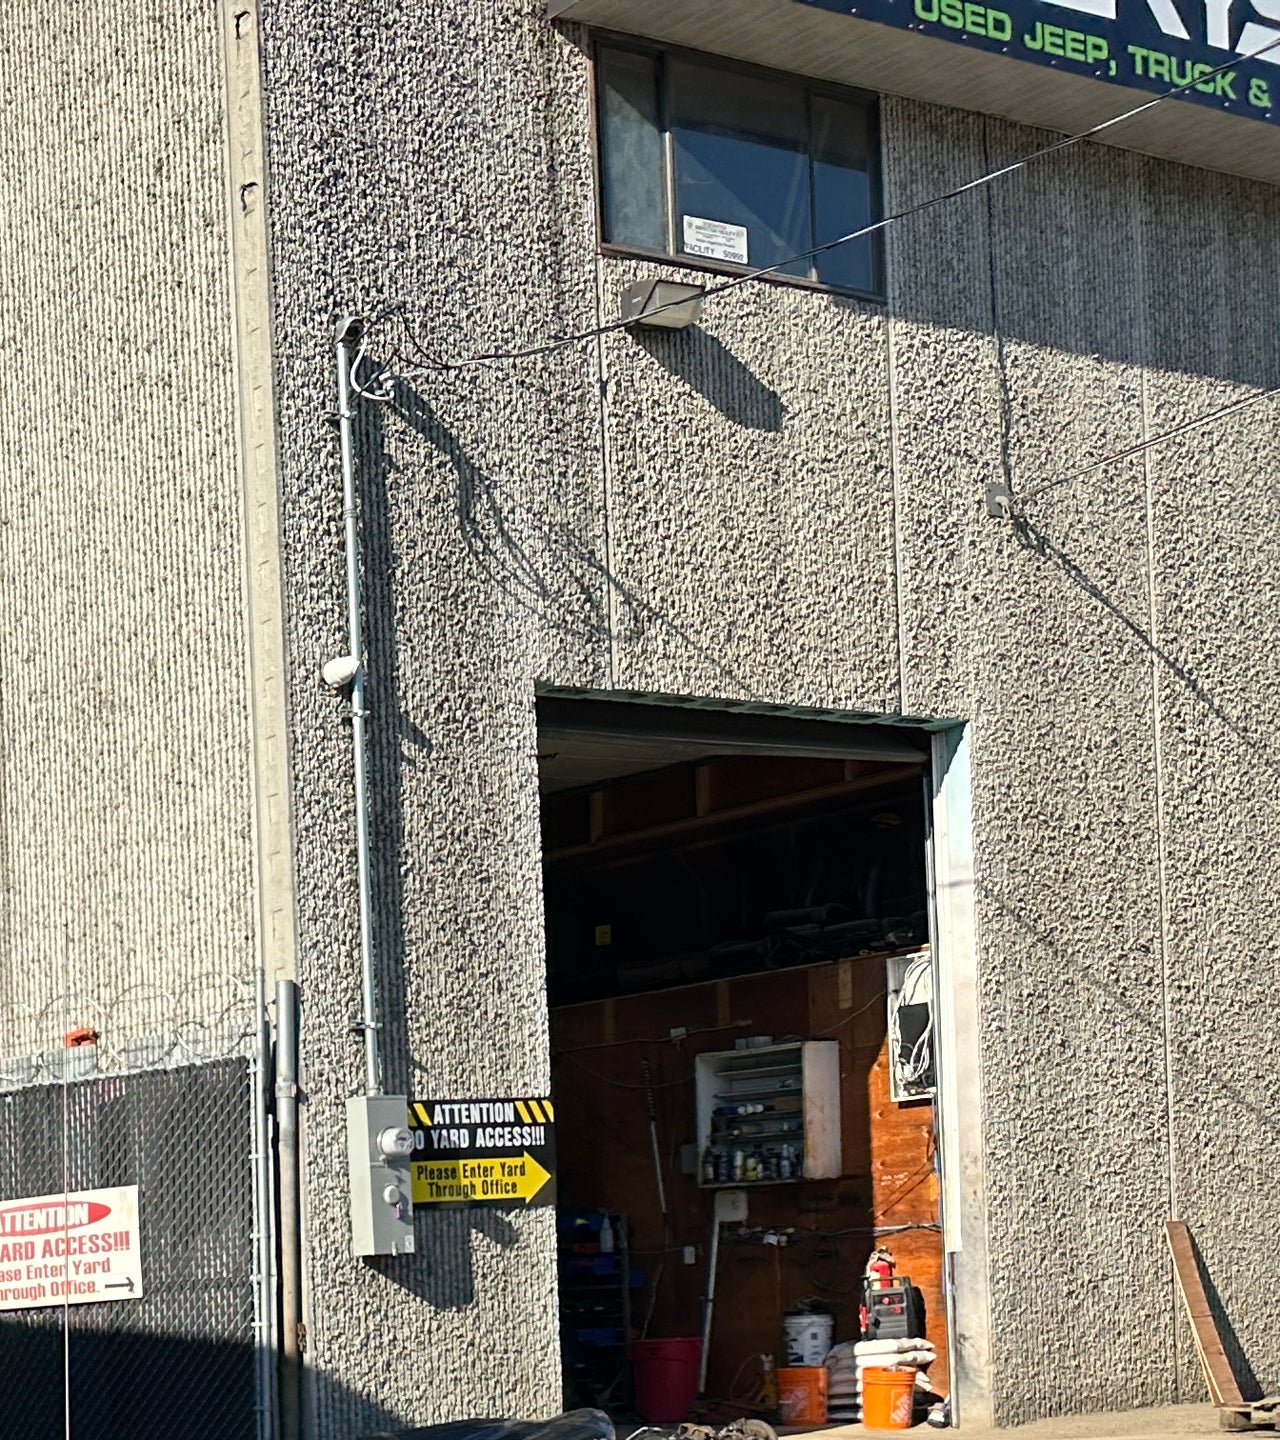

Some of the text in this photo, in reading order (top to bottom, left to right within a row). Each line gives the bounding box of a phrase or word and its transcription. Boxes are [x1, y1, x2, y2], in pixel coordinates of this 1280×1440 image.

[913, 0, 1011, 41] USED
[1024, 22, 1117, 76] JEEP,
[1128, 45, 1236, 99] TRUCK
[1248, 78, 1273, 108] &
[433, 1102, 515, 1125] ATTENTION
[430, 1128, 470, 1149] YARD
[475, 1125, 546, 1148] ACCESS!!!
[416, 1161, 526, 1181] Please Enter Yard
[427, 1178, 518, 1199] Through Office
[41, 1231, 131, 1260] ACCESS!!!
[26, 1262, 67, 1280] Enter
[72, 1257, 111, 1276] Yard
